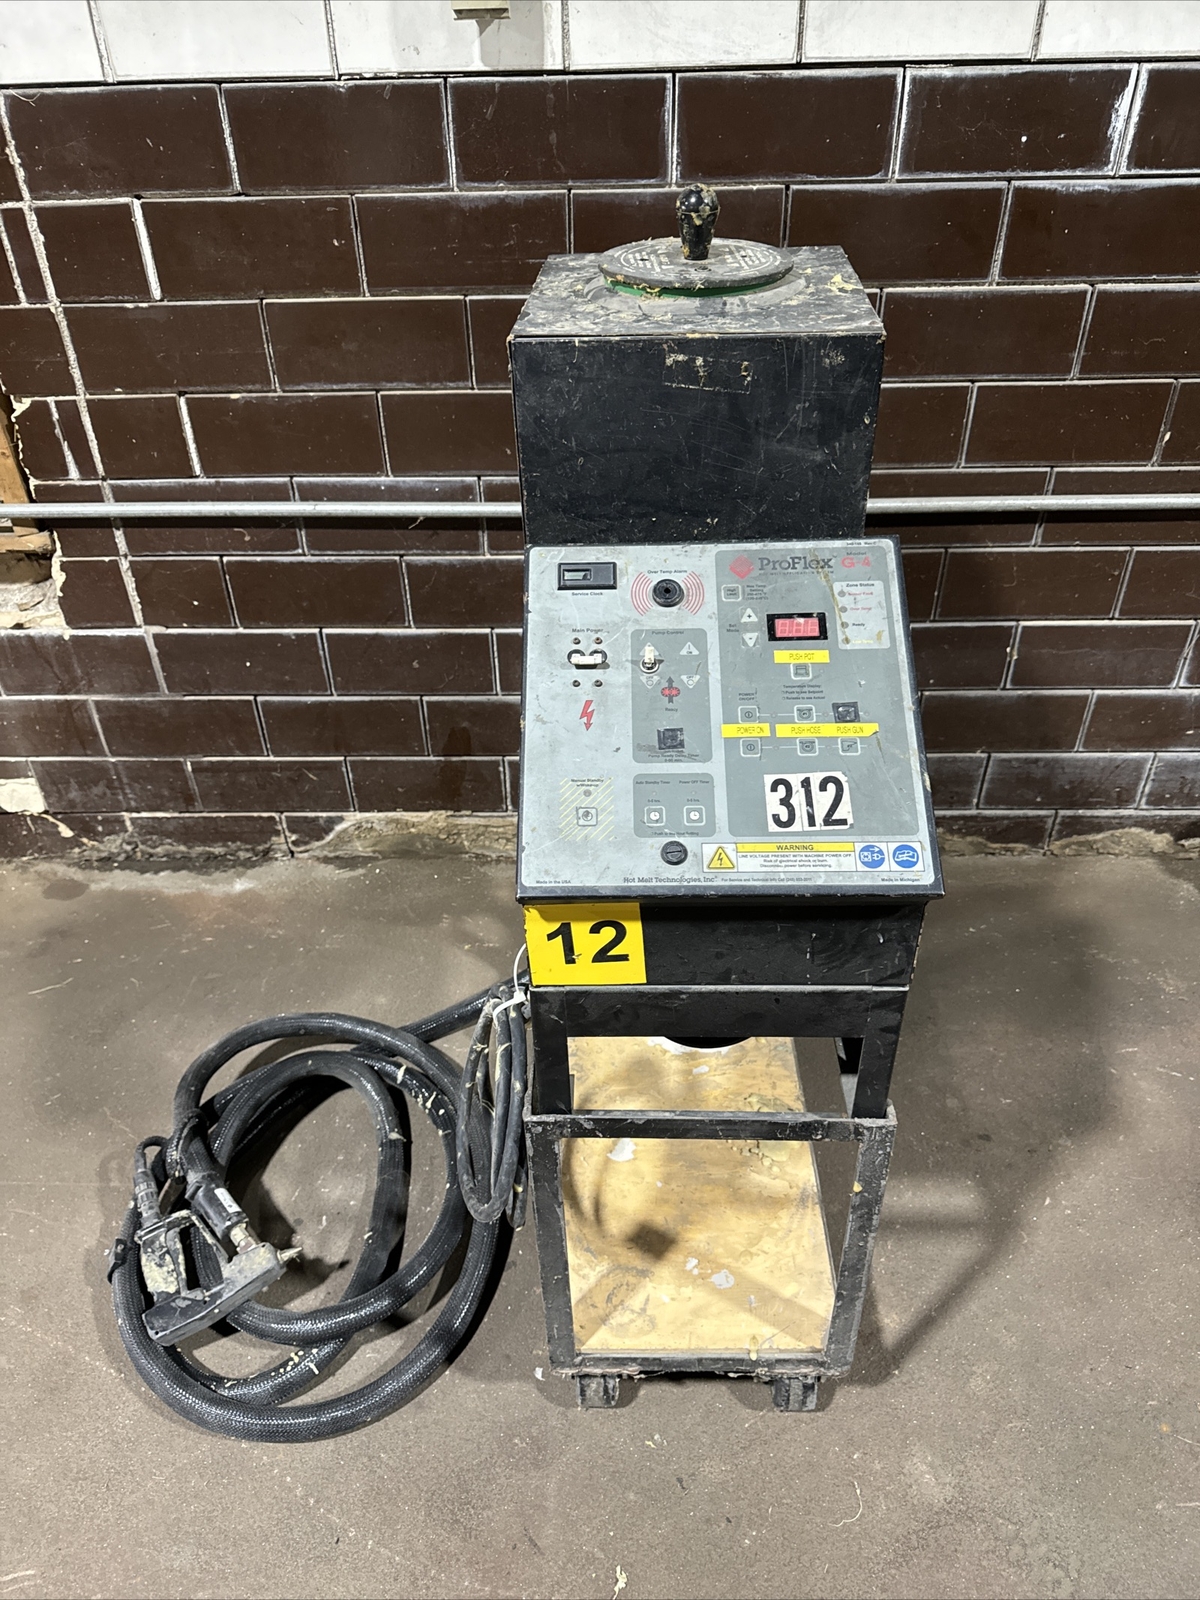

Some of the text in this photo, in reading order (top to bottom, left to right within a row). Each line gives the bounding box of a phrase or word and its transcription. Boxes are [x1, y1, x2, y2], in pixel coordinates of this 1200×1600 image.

[758, 556, 871, 570] ProFlex G-4
[770, 776, 848, 828] 312
[546, 920, 630, 964] 12
